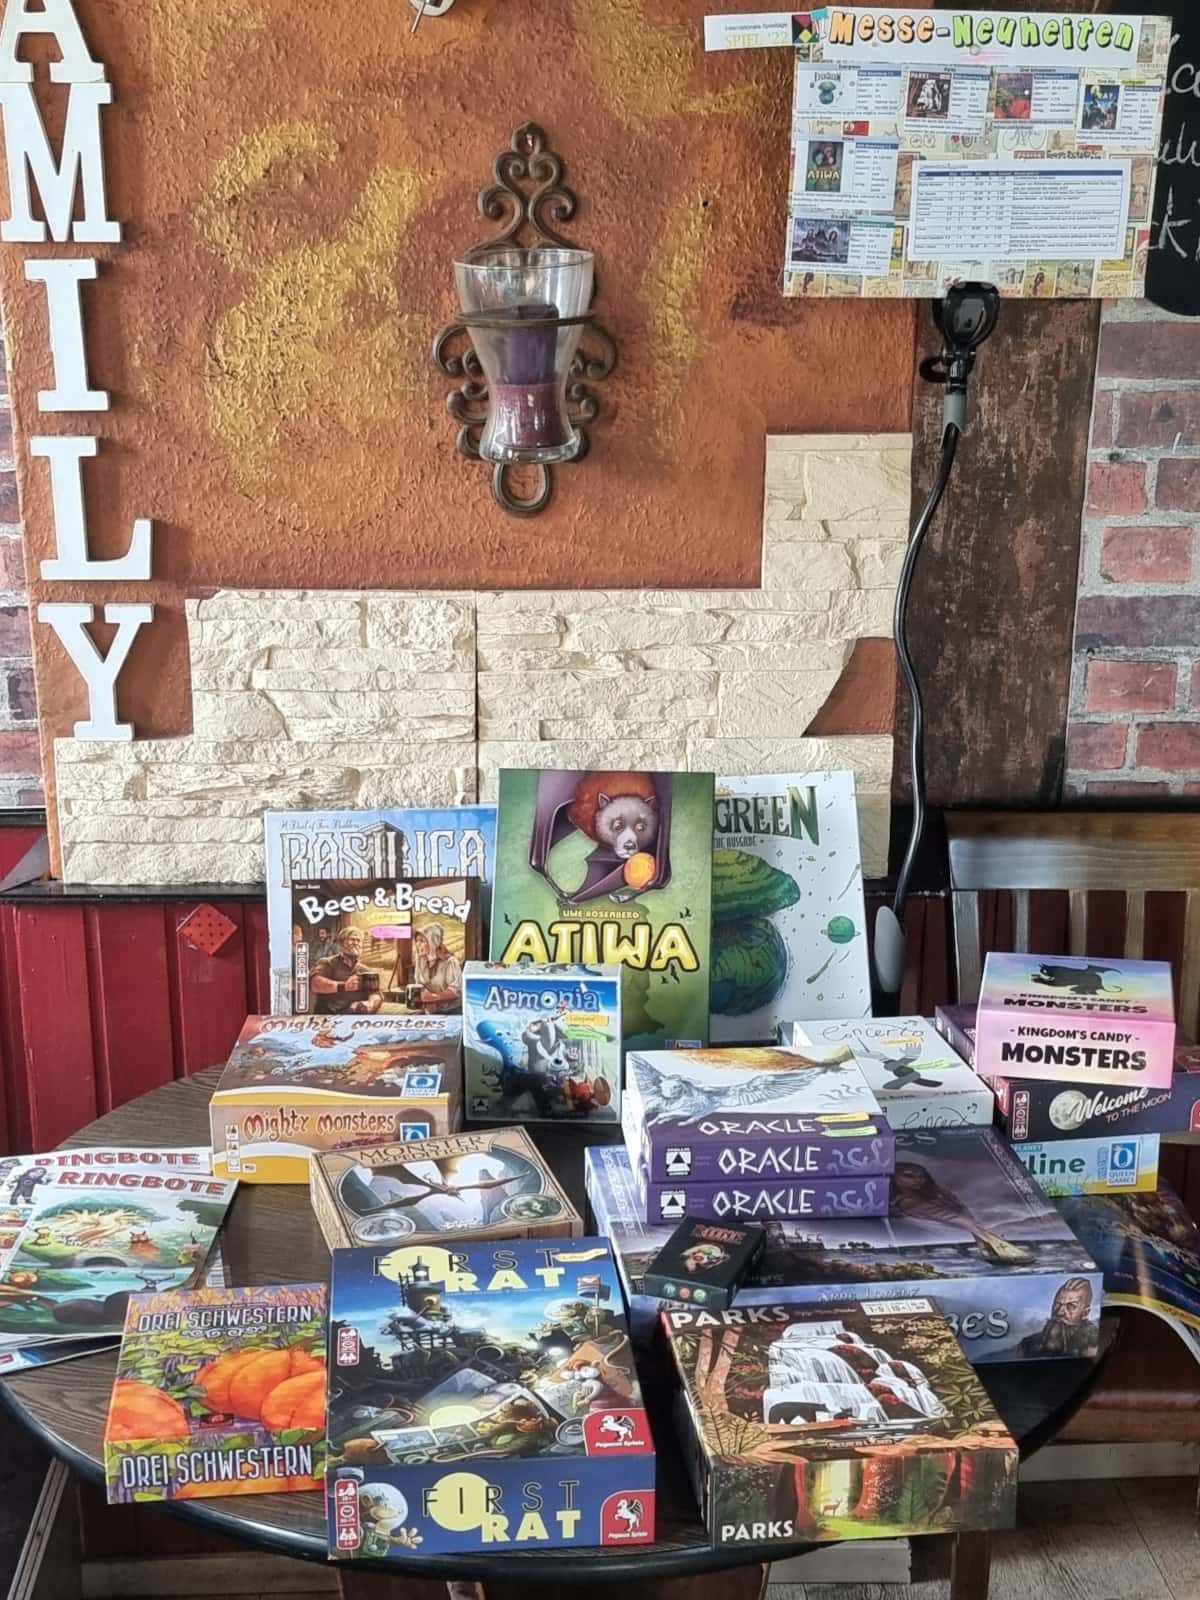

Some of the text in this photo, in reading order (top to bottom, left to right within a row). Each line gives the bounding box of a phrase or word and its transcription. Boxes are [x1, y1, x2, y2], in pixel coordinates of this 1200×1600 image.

[830, 9, 1134, 50] Messe-Neuheiten
[714, 786, 820, 846] GREEN
[299, 883, 472, 925] Beer & Bread
[500, 919, 700, 973] ATIWA
[484, 983, 600, 1012] Armonia
[1003, 998, 1148, 1014] MONSTERS
[1017, 1025, 1133, 1044] KINGDOM'S CANDY
[1001, 1042, 1147, 1071] MONSTERS
[1069, 1086, 1149, 1122] Welcome
[1105, 1091, 1172, 1123] TO THE MOON
[699, 1118, 817, 1136] ORACLE
[359, 1134, 486, 1161] MONSTER
[371, 1145, 480, 1165] EXPEDITION
[719, 1146, 821, 1174] ORACLE
[1022, 1152, 1086, 1176] line
[57, 1171, 229, 1197] RINGBOTE
[713, 1189, 815, 1217] ORACLE
[444, 1267, 565, 1293] RAT
[138, 1305, 312, 1333] DREI SCHWESTERN
[670, 1305, 792, 1329] PARKS
[121, 1444, 313, 1489] DREI SCHWESTERN
[422, 1480, 580, 1517] FIRST
[480, 1509, 582, 1544] RAT
[721, 1520, 794, 1541] PARKS
